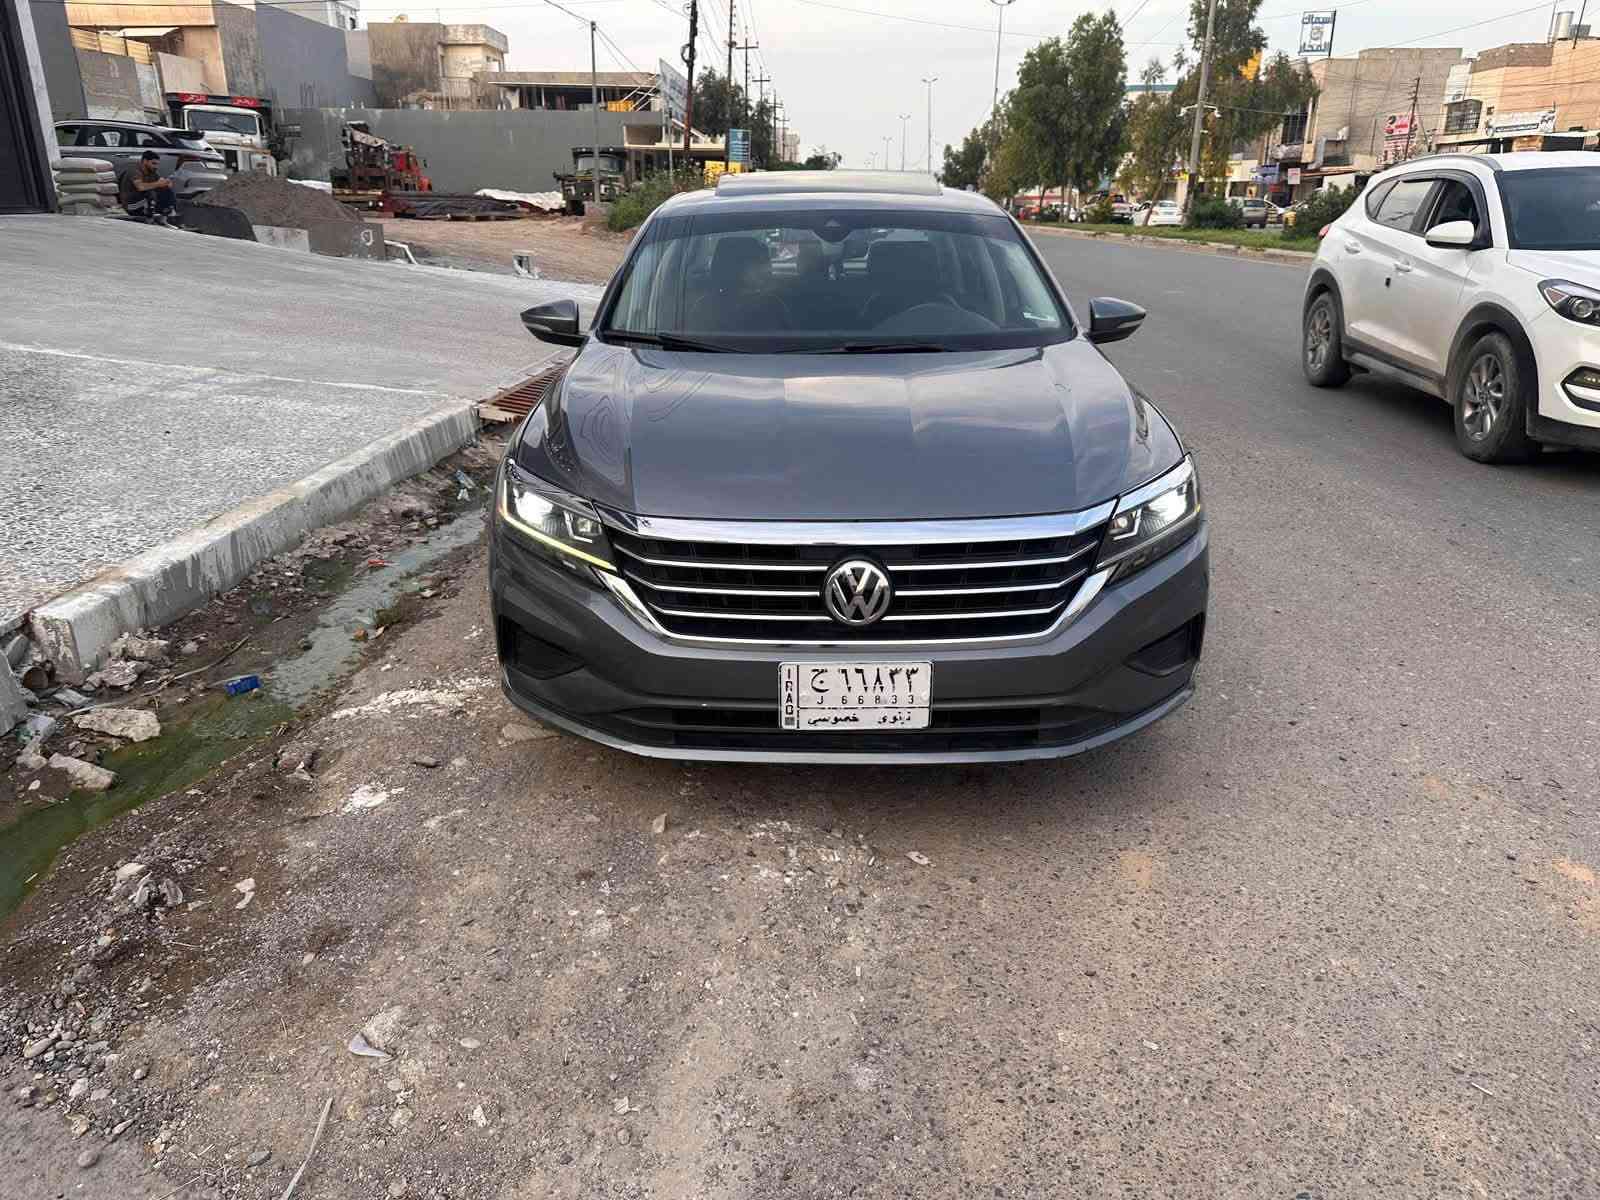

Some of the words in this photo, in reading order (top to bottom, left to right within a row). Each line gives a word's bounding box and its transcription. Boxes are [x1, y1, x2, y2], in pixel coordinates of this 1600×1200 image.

[828, 562, 889, 624] VW
[785, 668, 794, 715] IRAQ
[810, 667, 830, 693] ج
[839, 667, 919, 693] ٦٦٨٣٣
[816, 696, 825, 705] J
[841, 695, 915, 705] 66833
